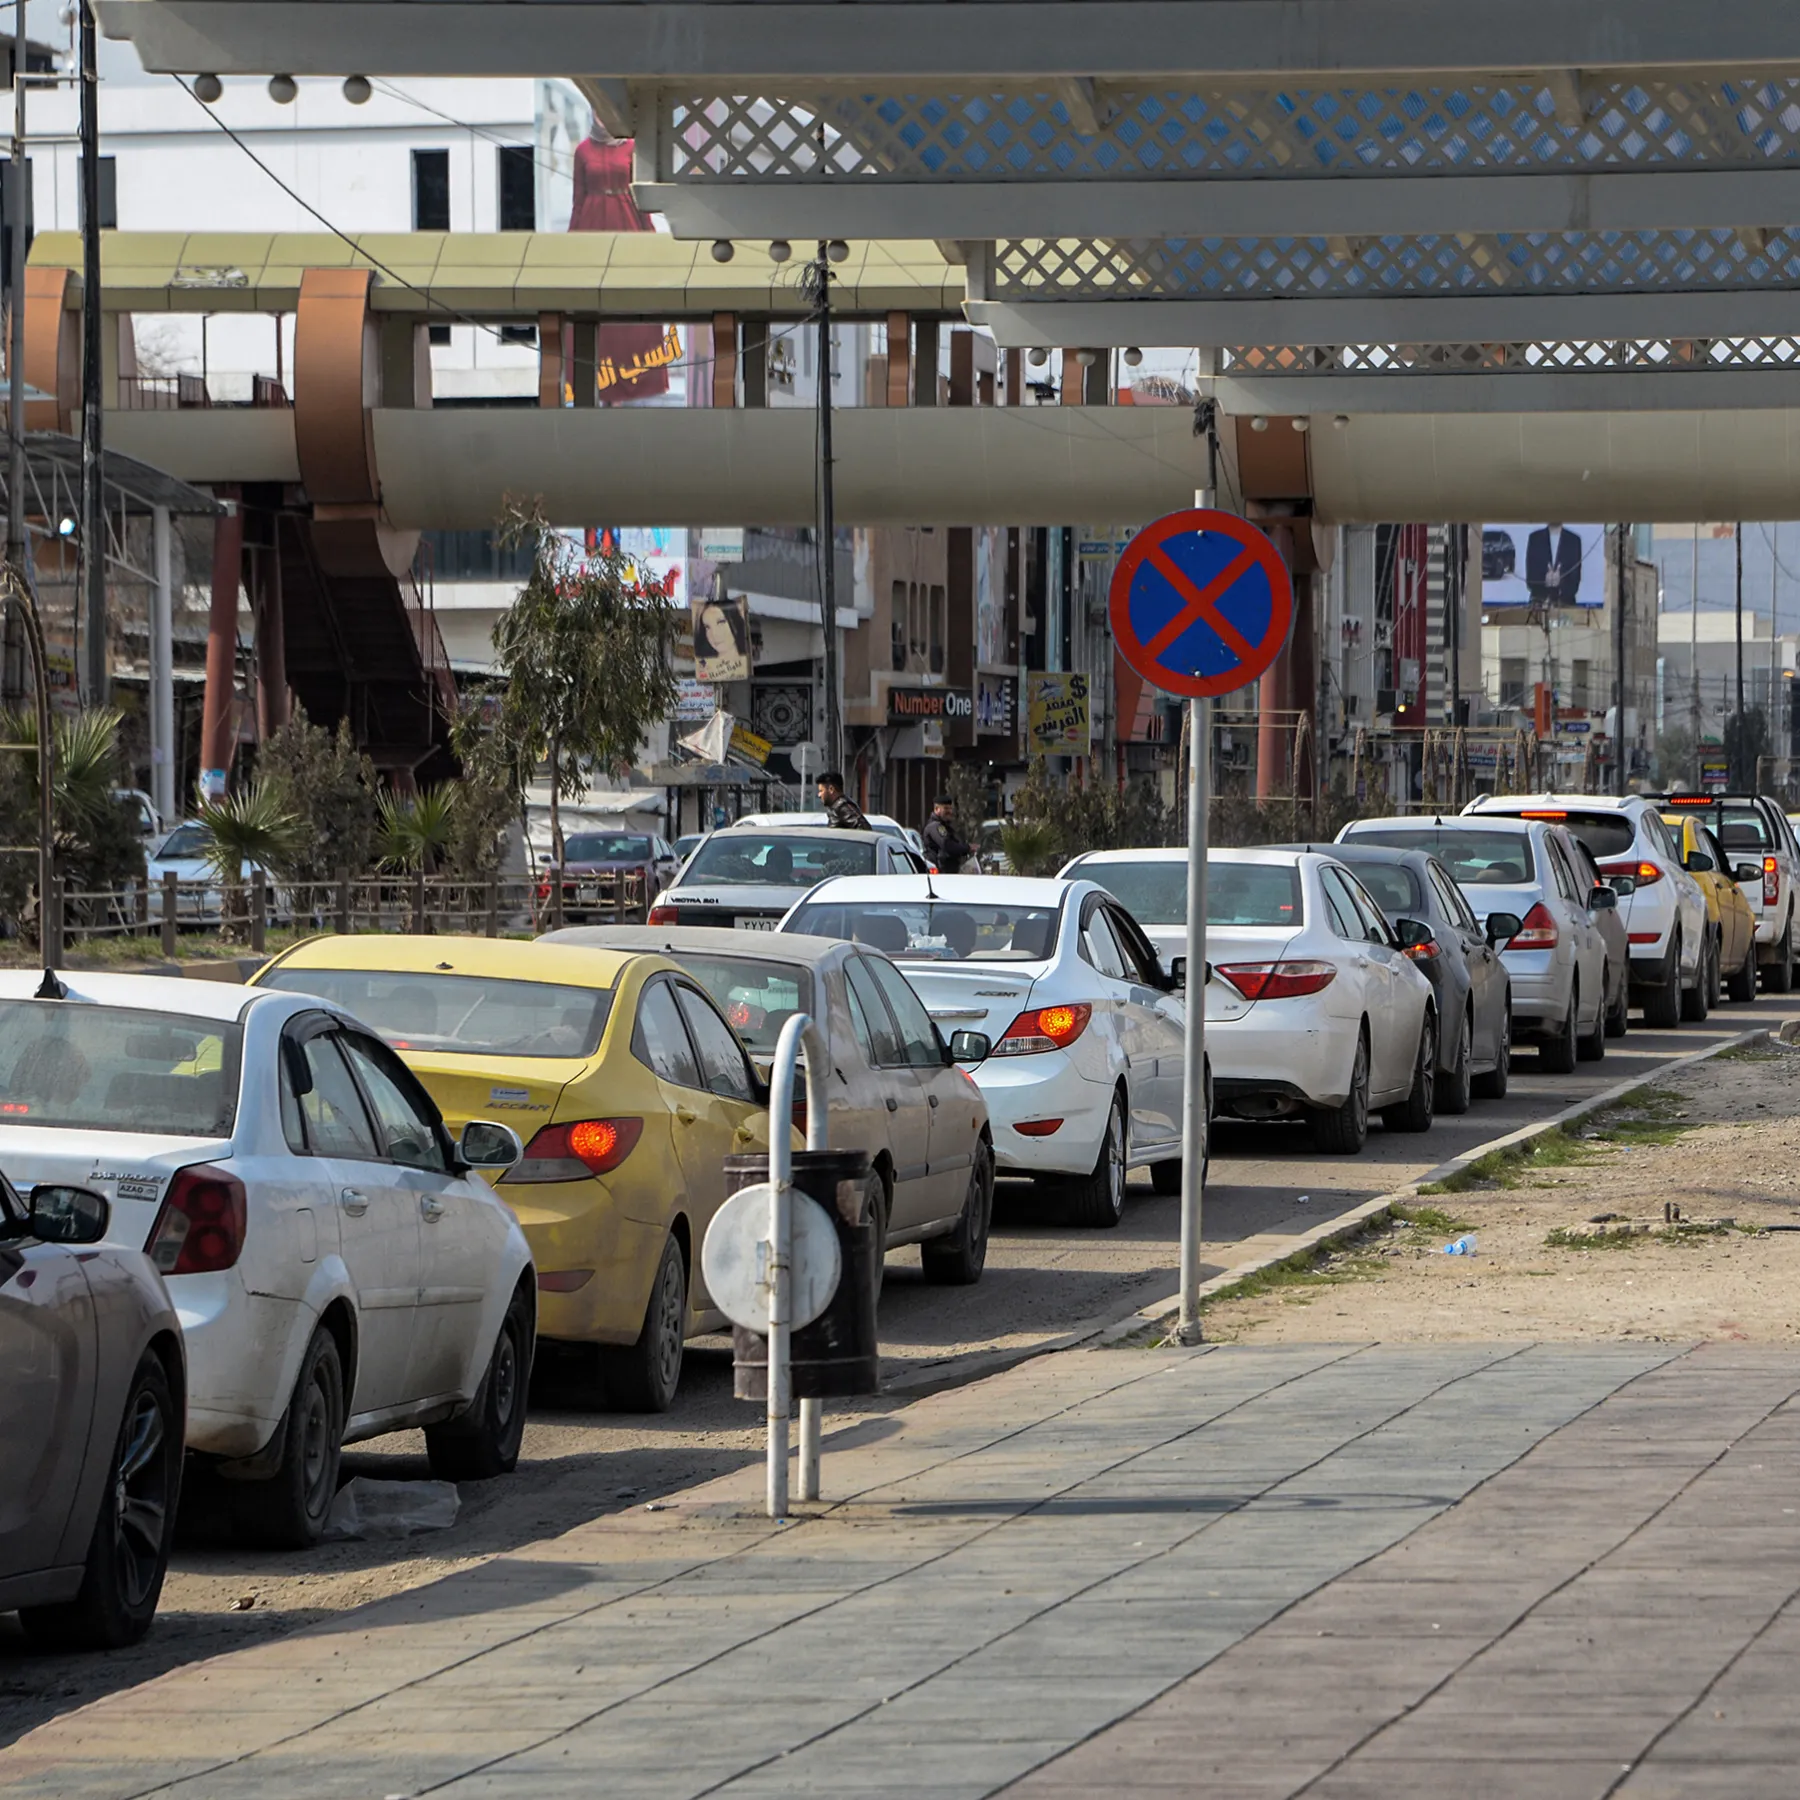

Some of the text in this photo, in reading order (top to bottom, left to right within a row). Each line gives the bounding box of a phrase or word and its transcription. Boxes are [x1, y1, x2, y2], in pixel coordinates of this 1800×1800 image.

[895, 692, 944, 714] Number
[946, 692, 972, 716] One
[973, 990, 1019, 998] ACCENT
[484, 1102, 552, 1112] ACCENT
